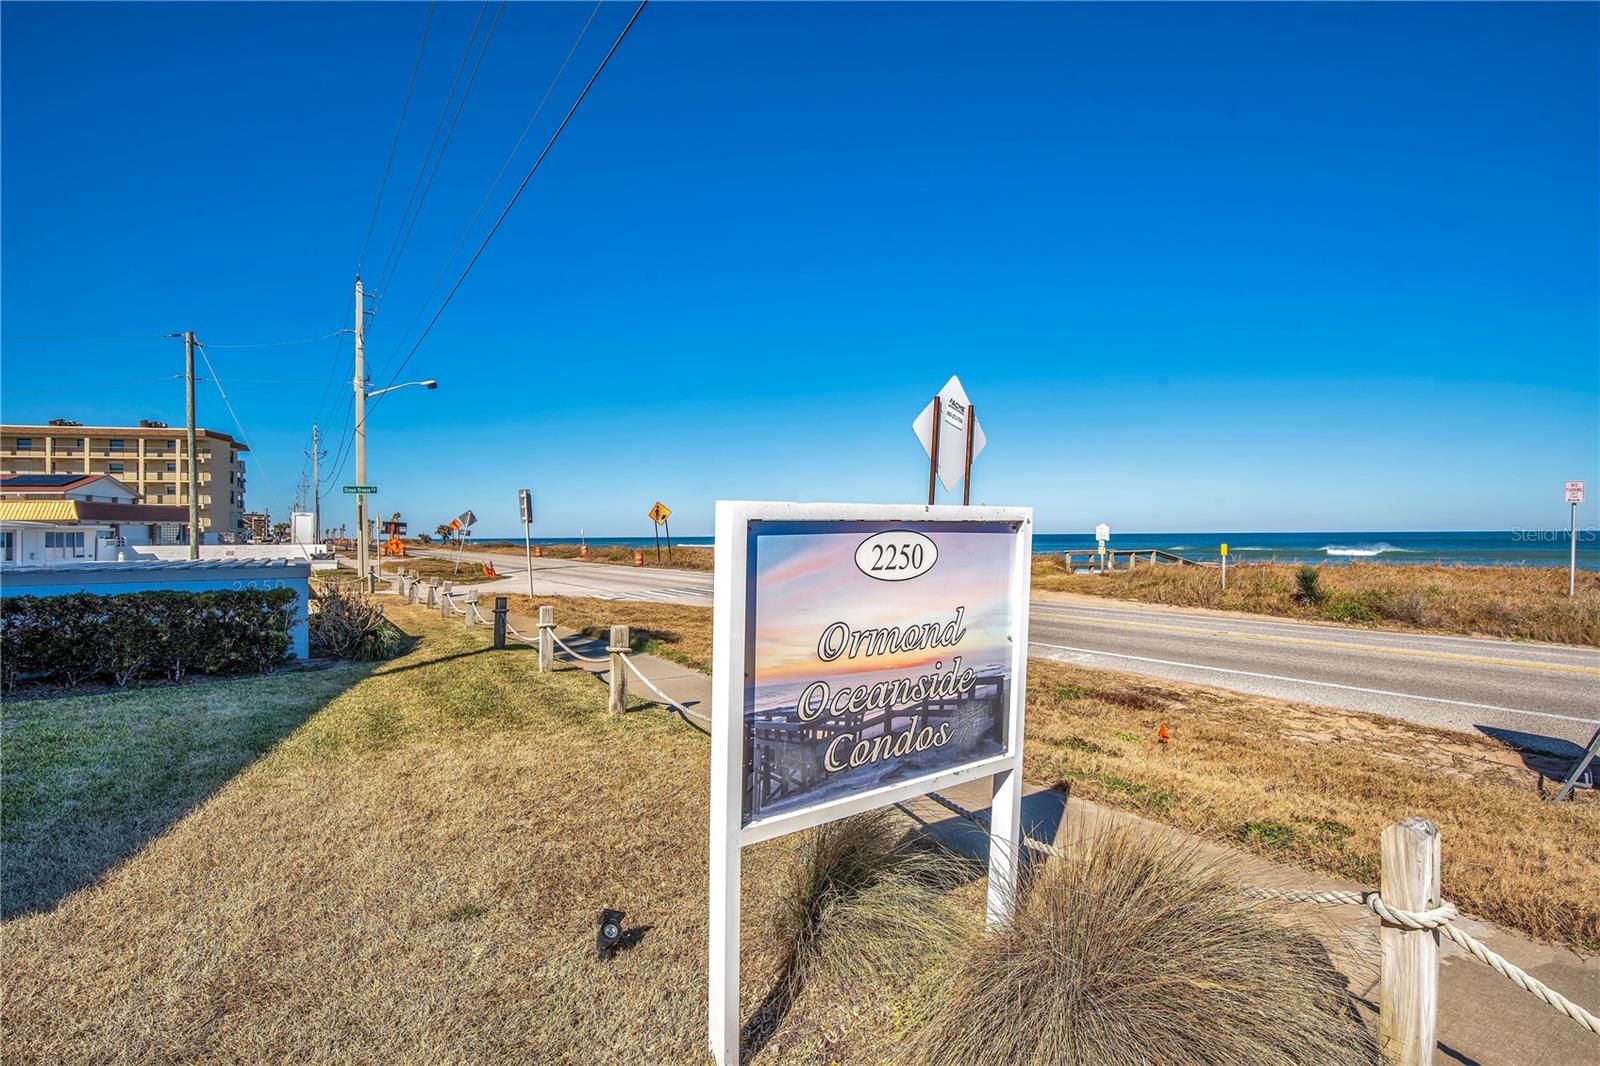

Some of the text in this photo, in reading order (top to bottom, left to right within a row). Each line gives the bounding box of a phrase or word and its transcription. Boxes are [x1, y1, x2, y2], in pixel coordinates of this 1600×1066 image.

[870, 543, 924, 571] 2250
[816, 606, 968, 662] Ormond
[796, 656, 977, 722] Oceanside
[822, 714, 955, 774] Condos
